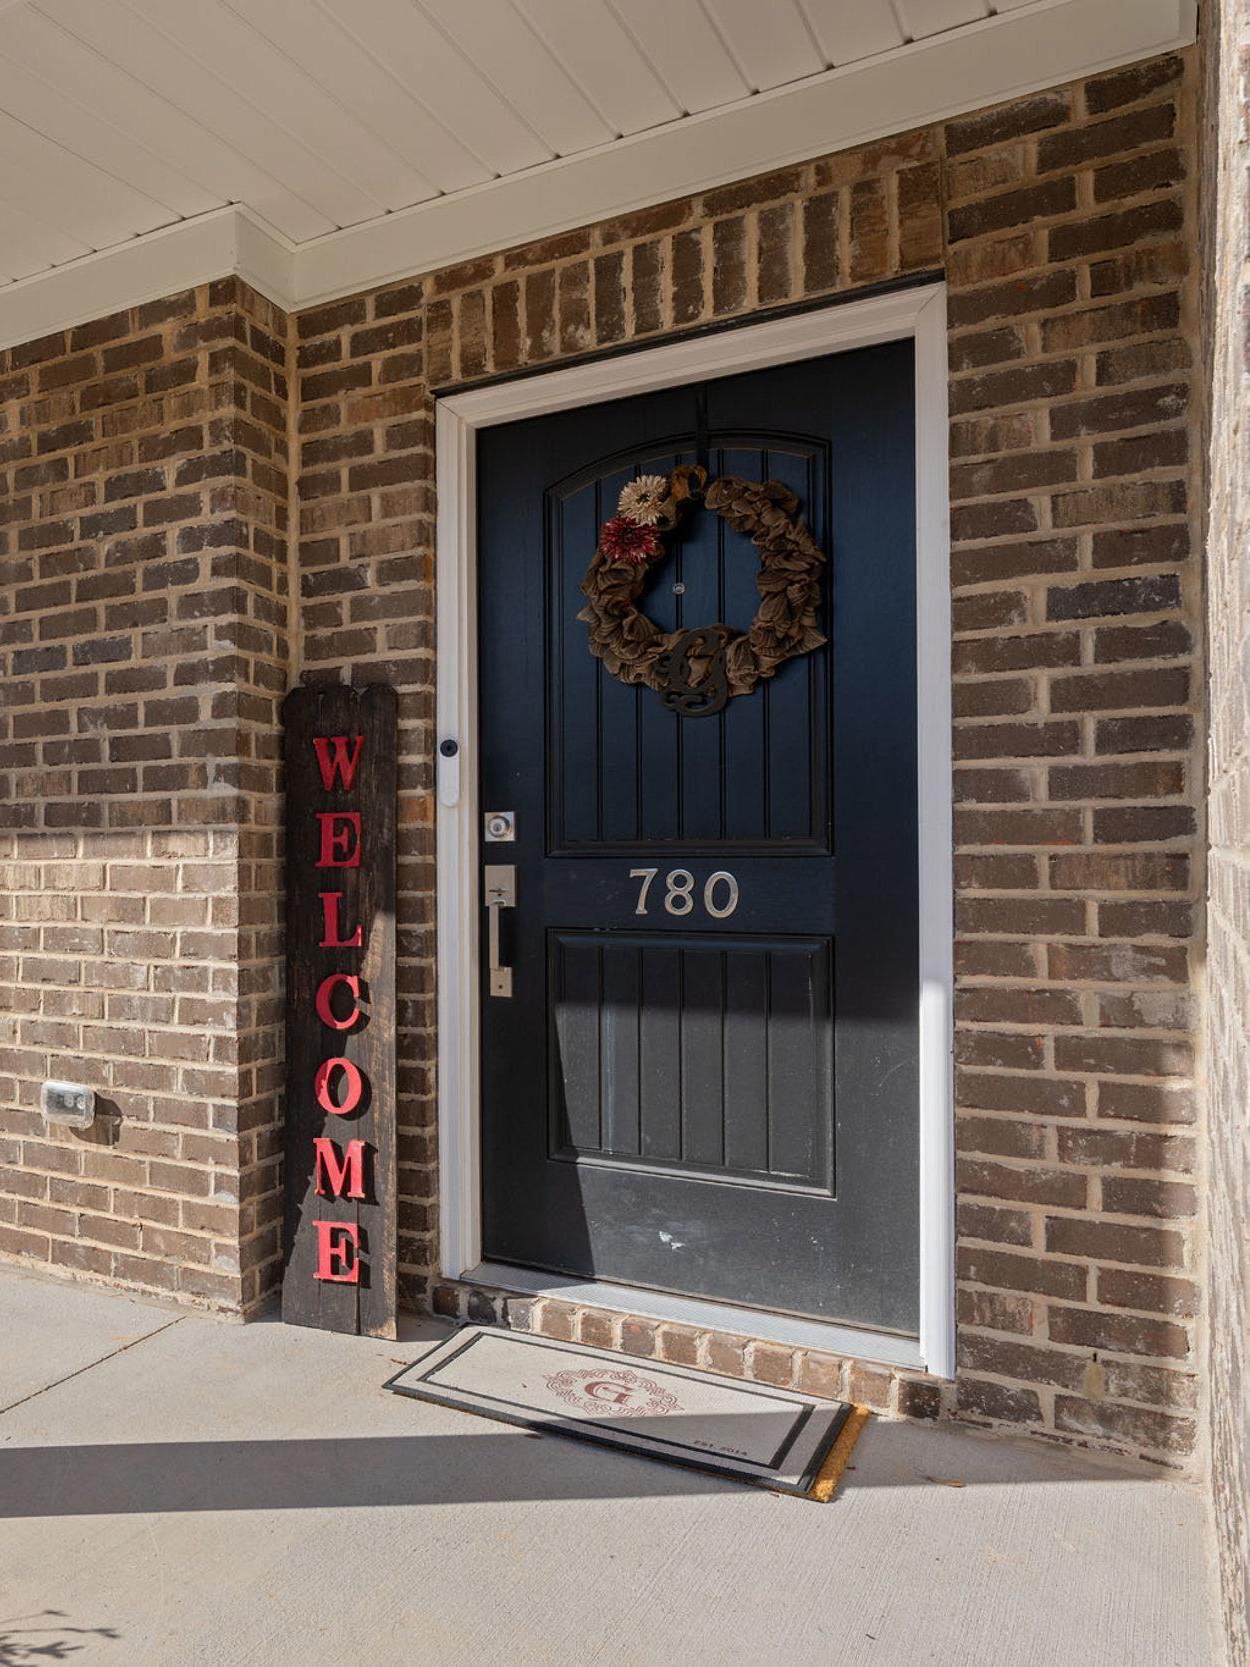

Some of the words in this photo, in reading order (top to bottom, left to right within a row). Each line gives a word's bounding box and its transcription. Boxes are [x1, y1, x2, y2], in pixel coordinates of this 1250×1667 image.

[629, 868, 739, 918] 780
[312, 735, 366, 1284] WELCOME
[584, 1381, 635, 1404] G
